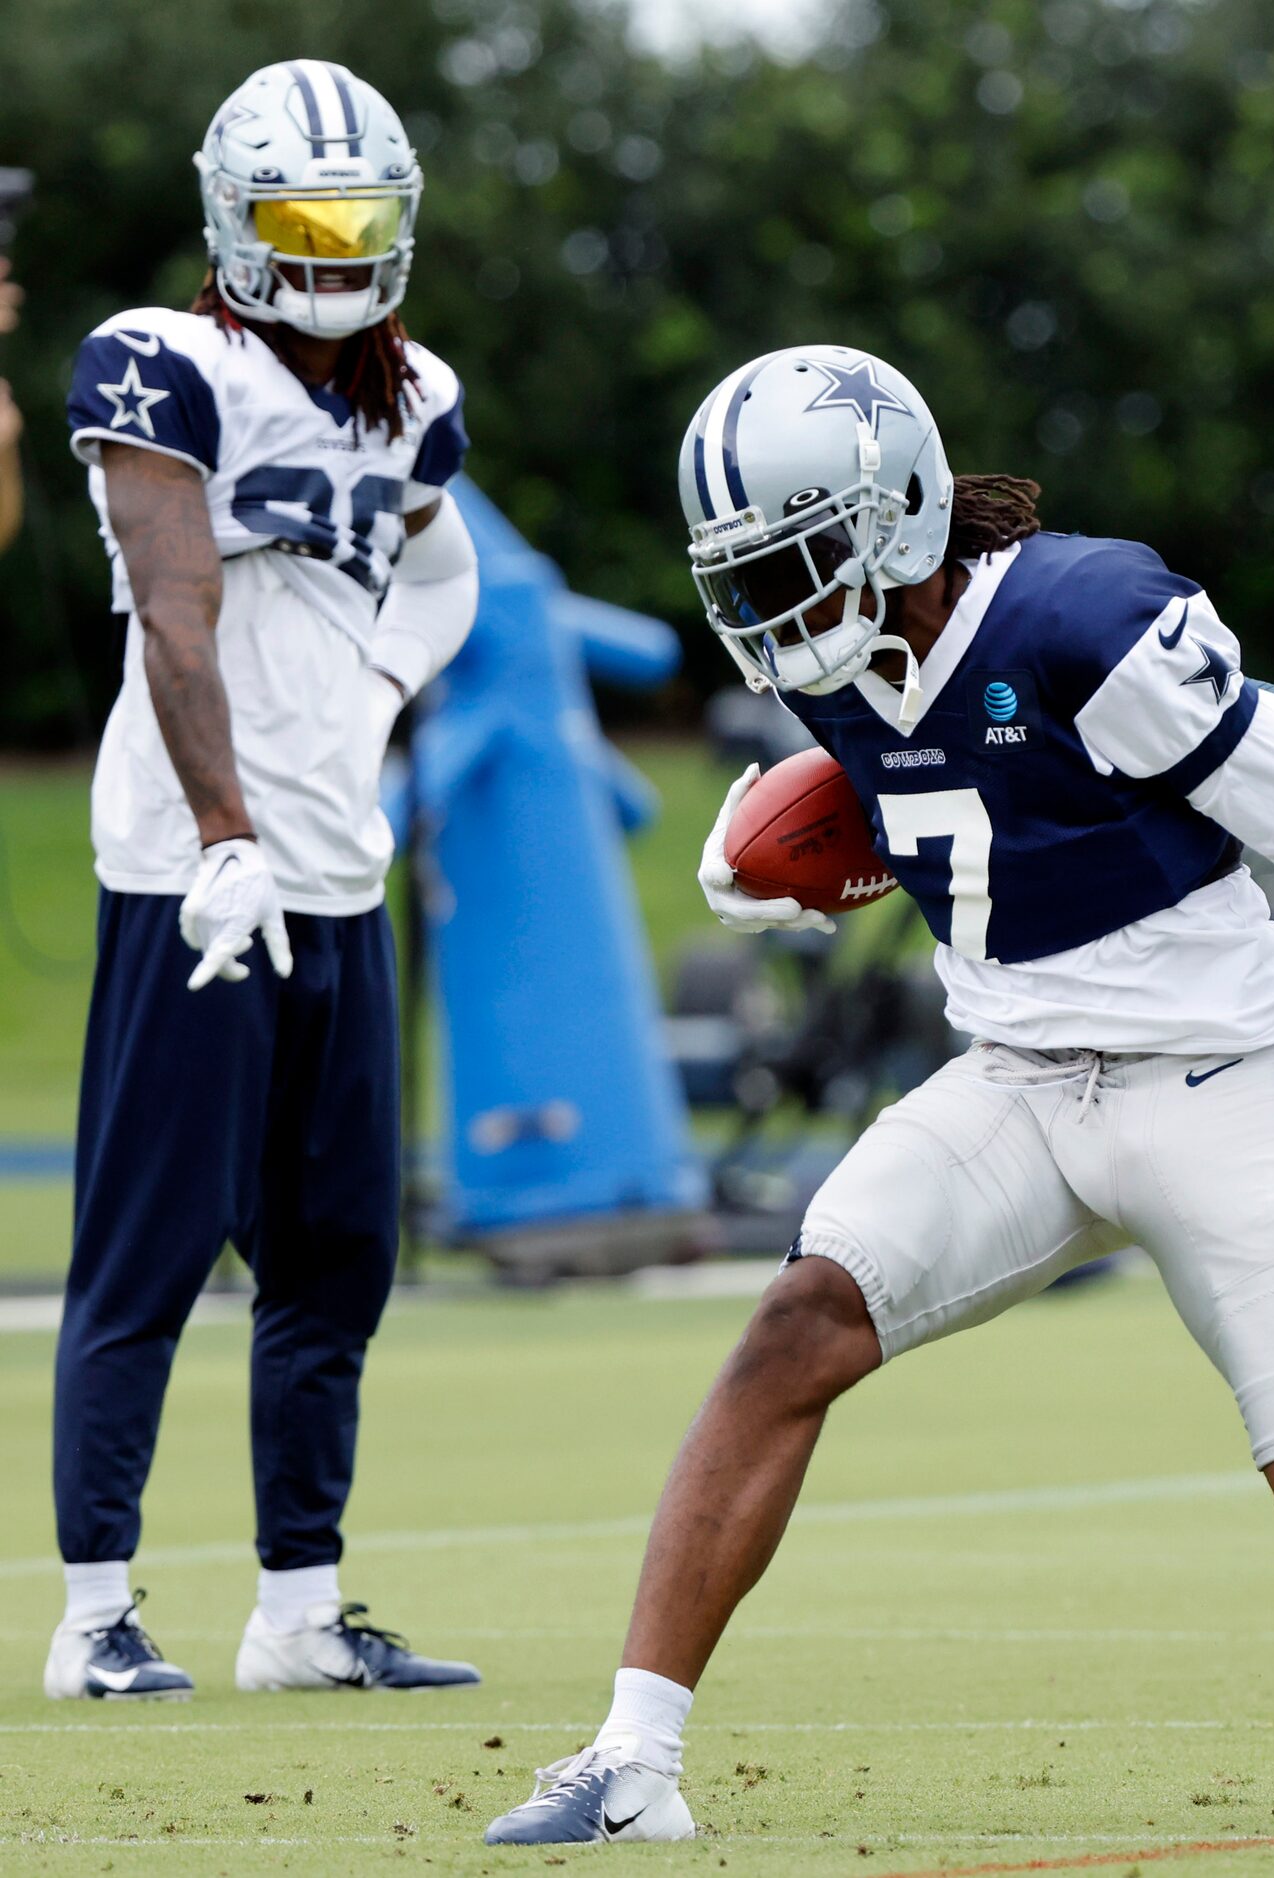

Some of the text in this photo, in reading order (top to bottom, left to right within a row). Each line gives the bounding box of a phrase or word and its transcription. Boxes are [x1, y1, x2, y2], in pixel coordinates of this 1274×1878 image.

[985, 726, 1027, 745] AT&T
[881, 749, 946, 768] COWBOYS
[877, 788, 993, 962] 7
